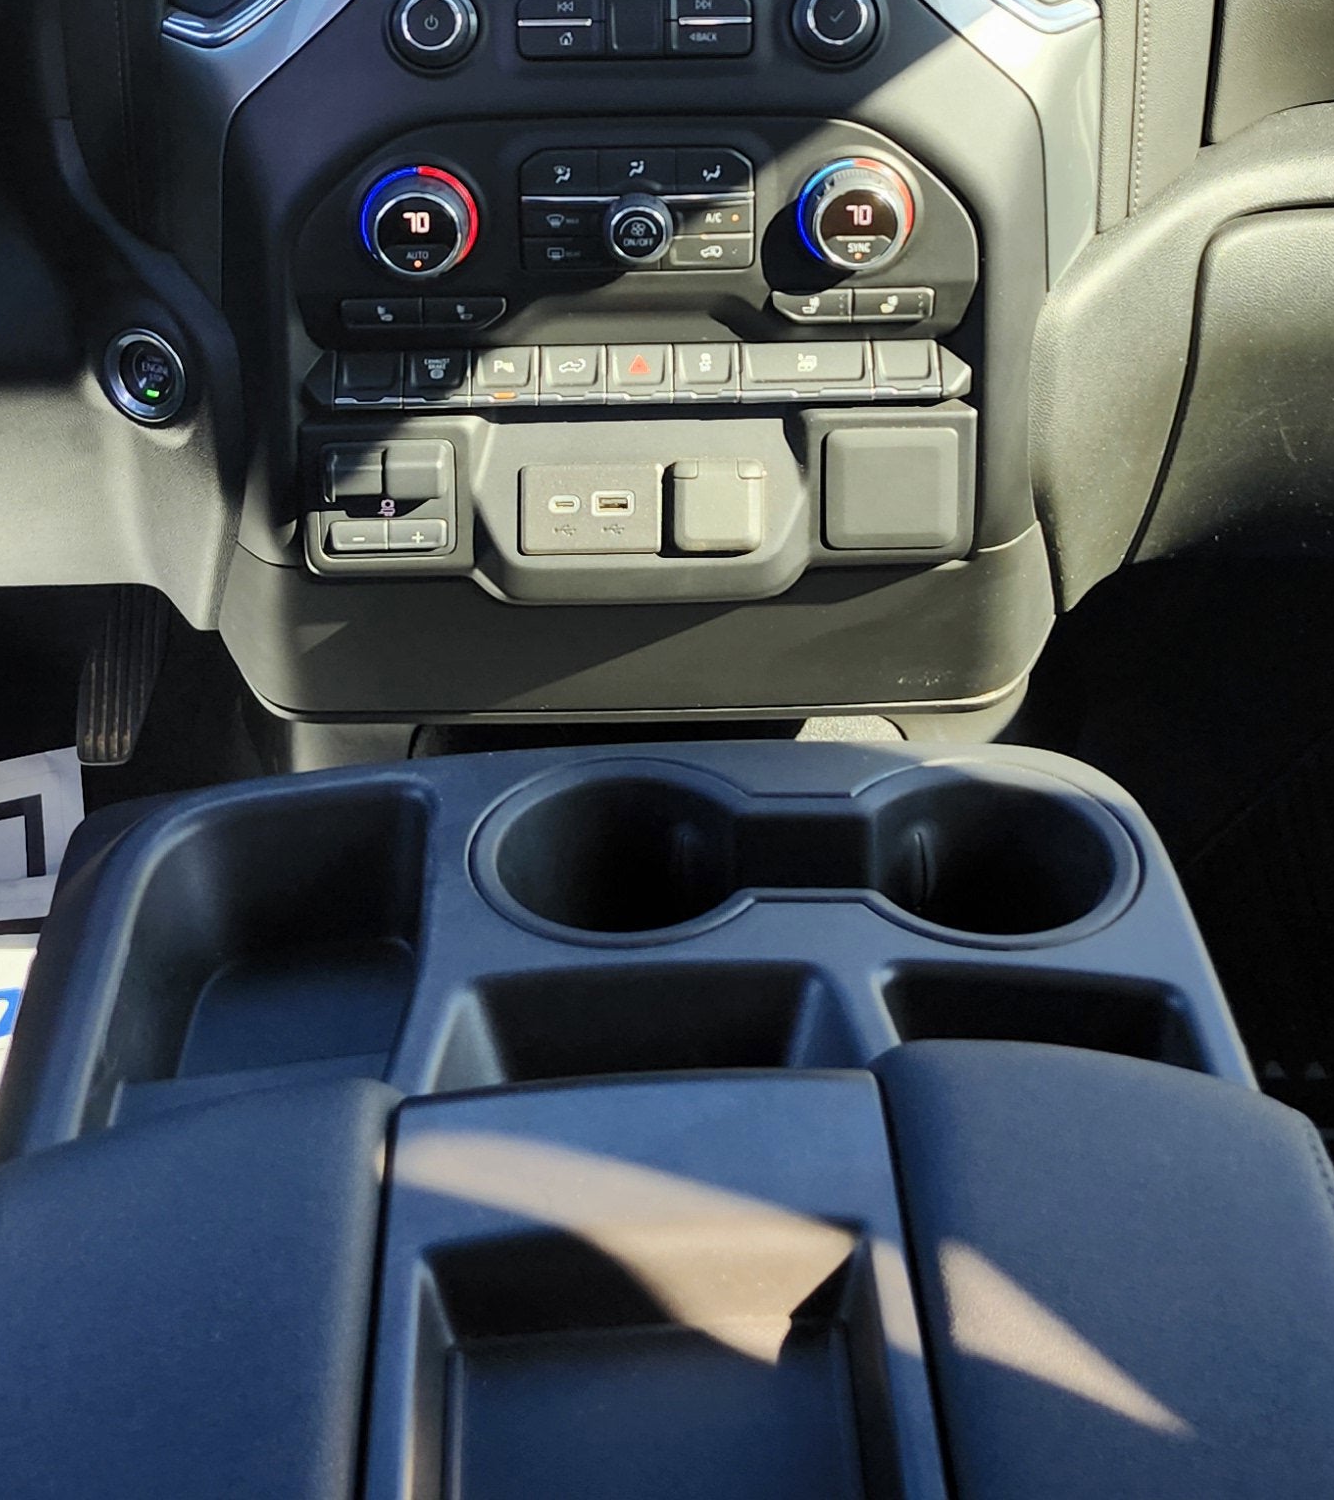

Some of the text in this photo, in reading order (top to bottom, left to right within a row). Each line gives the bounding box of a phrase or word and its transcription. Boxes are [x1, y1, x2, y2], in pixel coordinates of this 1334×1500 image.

[705, 212, 722, 224] A/C
[846, 205, 873, 225] 70
[403, 212, 430, 233] 70
[623, 238, 654, 247] ON/OFF
[847, 242, 871, 253] SYNC
[406, 251, 429, 260] AUTO
